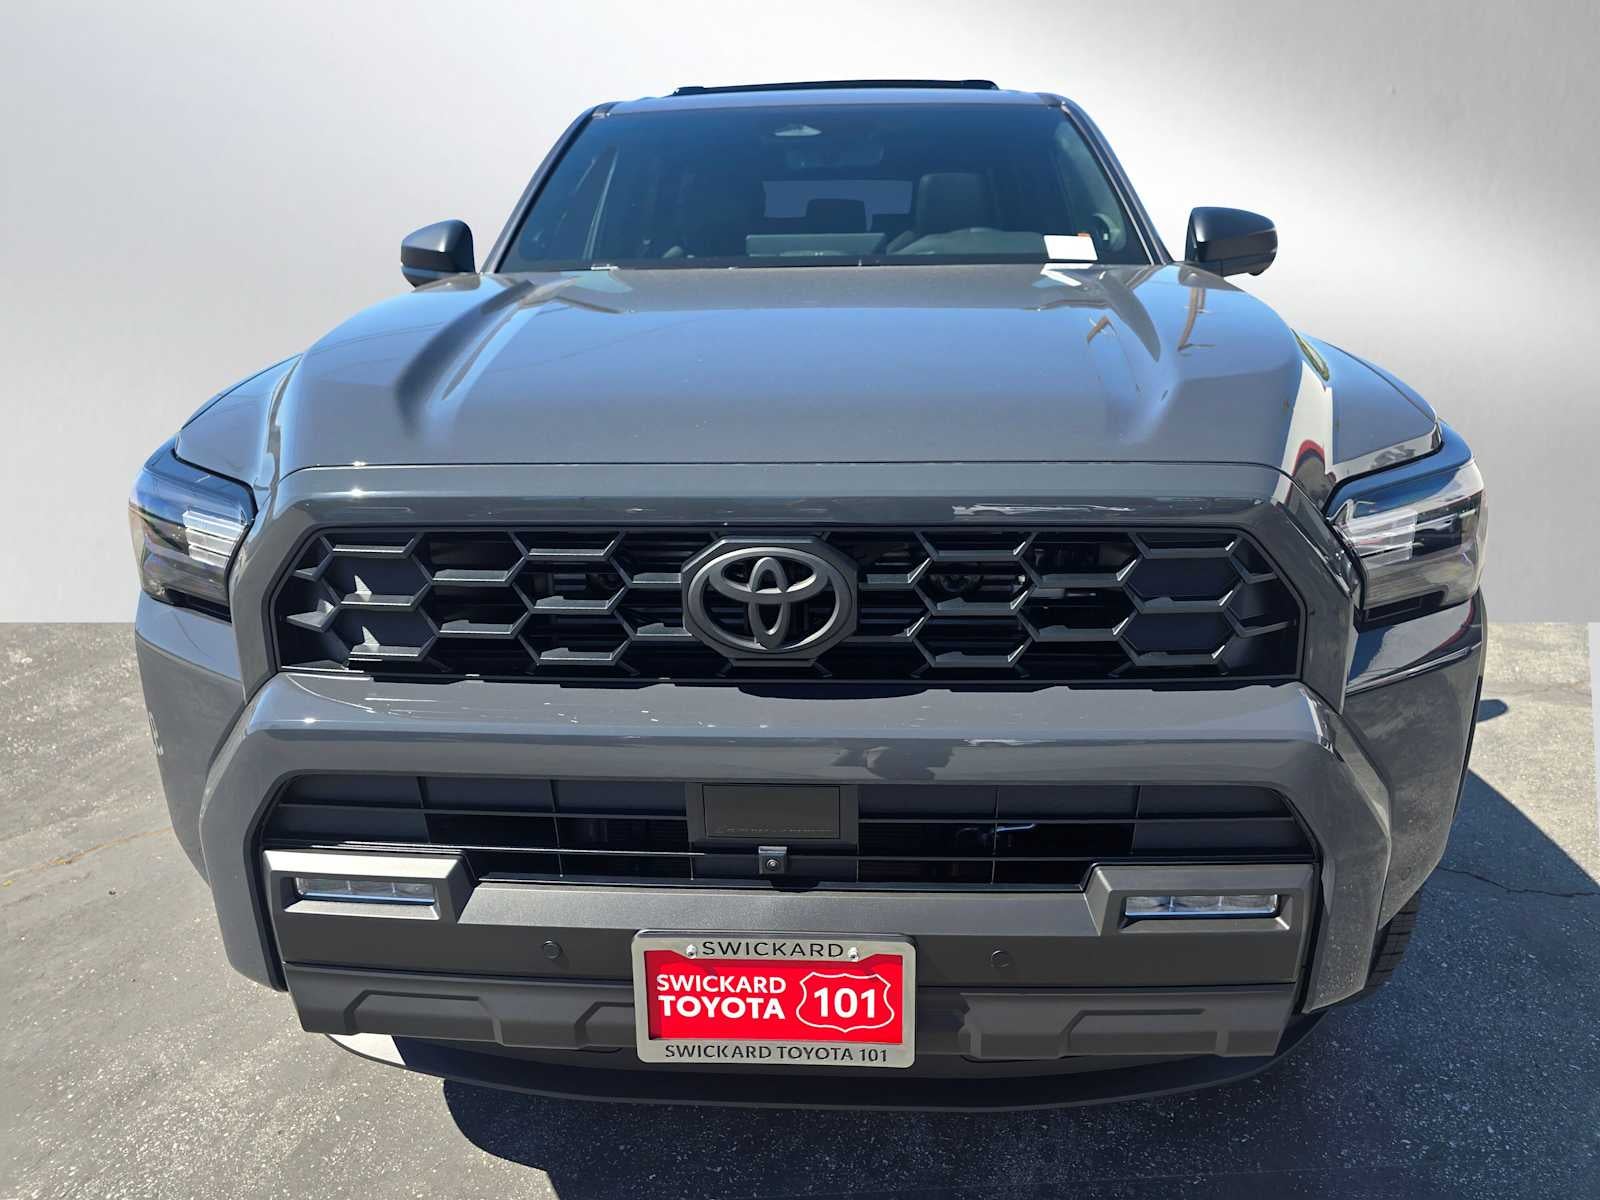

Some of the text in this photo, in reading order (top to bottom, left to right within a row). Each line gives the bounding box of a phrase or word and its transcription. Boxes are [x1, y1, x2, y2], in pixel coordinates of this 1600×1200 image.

[702, 941, 844, 958] SWICKARD
[656, 974, 787, 994] SWICKARD
[657, 995, 786, 1020] TOYOTA
[813, 987, 876, 1019] 101
[665, 1044, 888, 1063] SWICKARD TOYOTA 101
